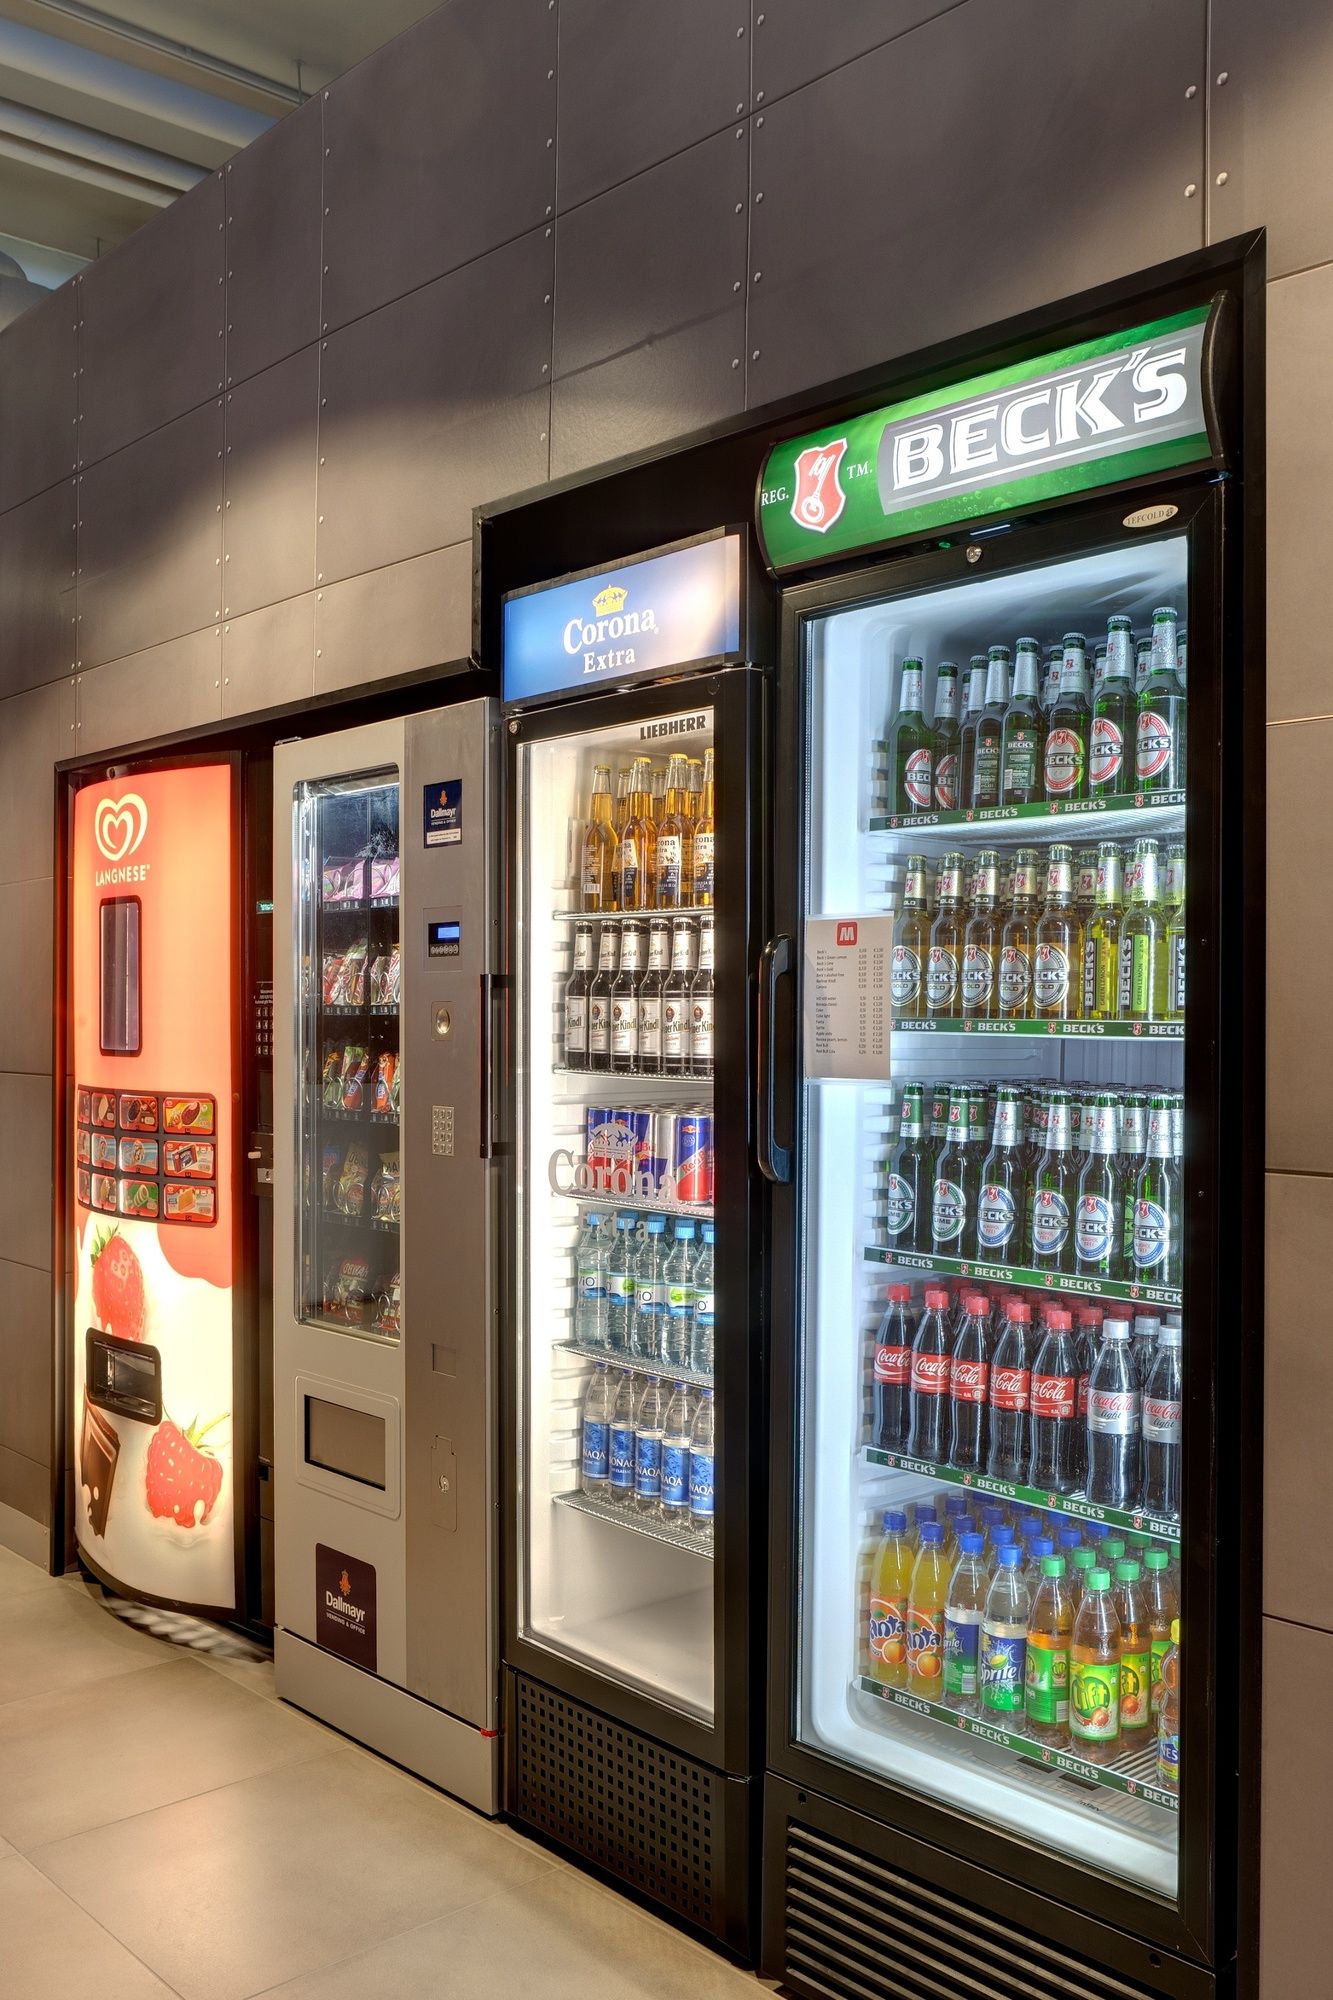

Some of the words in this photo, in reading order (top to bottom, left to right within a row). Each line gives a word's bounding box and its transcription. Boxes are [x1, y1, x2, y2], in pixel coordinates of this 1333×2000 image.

[893, 346, 1188, 490] BECK'S
[847, 462, 873, 480] TM.
[761, 487, 790, 506] REG.
[1127, 509, 1166, 526] TEFCOLD
[563, 608, 657, 654] Corona
[583, 648, 636, 674] Extra
[640, 715, 706, 740] LIEBHERR
[430, 807, 457, 819] Dallmayr
[980, 807, 1018, 819] BECK'S
[1064, 799, 1106, 812] BECK'S
[903, 814, 939, 826] BECK'S
[95, 864, 147, 887] LANGNESE
[901, 1019, 937, 1030] BECK'S
[978, 1020, 1016, 1032] BECK'S
[1062, 1022, 1105, 1033] BECK'S
[548, 1149, 677, 1203] Corona
[897, 1255, 933, 1269] BECK'S
[974, 1267, 1013, 1280] BECK'S
[1059, 1278, 1102, 1292] BECK'S
[1091, 1391, 1134, 1411] Coca-Cola
[1101, 1410, 1122, 1420] light
[1154, 1418, 1175, 1428] light
[900, 1460, 936, 1476] BECK'S
[977, 1478, 1016, 1496] BECK'S
[1062, 1500, 1105, 1518] BECK'S
[325, 1590, 366, 1622] Dallmayr
[981, 1662, 1017, 1685] Sprite
[894, 1693, 931, 1714] BECK'S
[1072, 1680, 1108, 1711] Lift
[971, 1722, 1010, 1745] BECK'S
[1056, 1756, 1099, 1780] BECK'S
